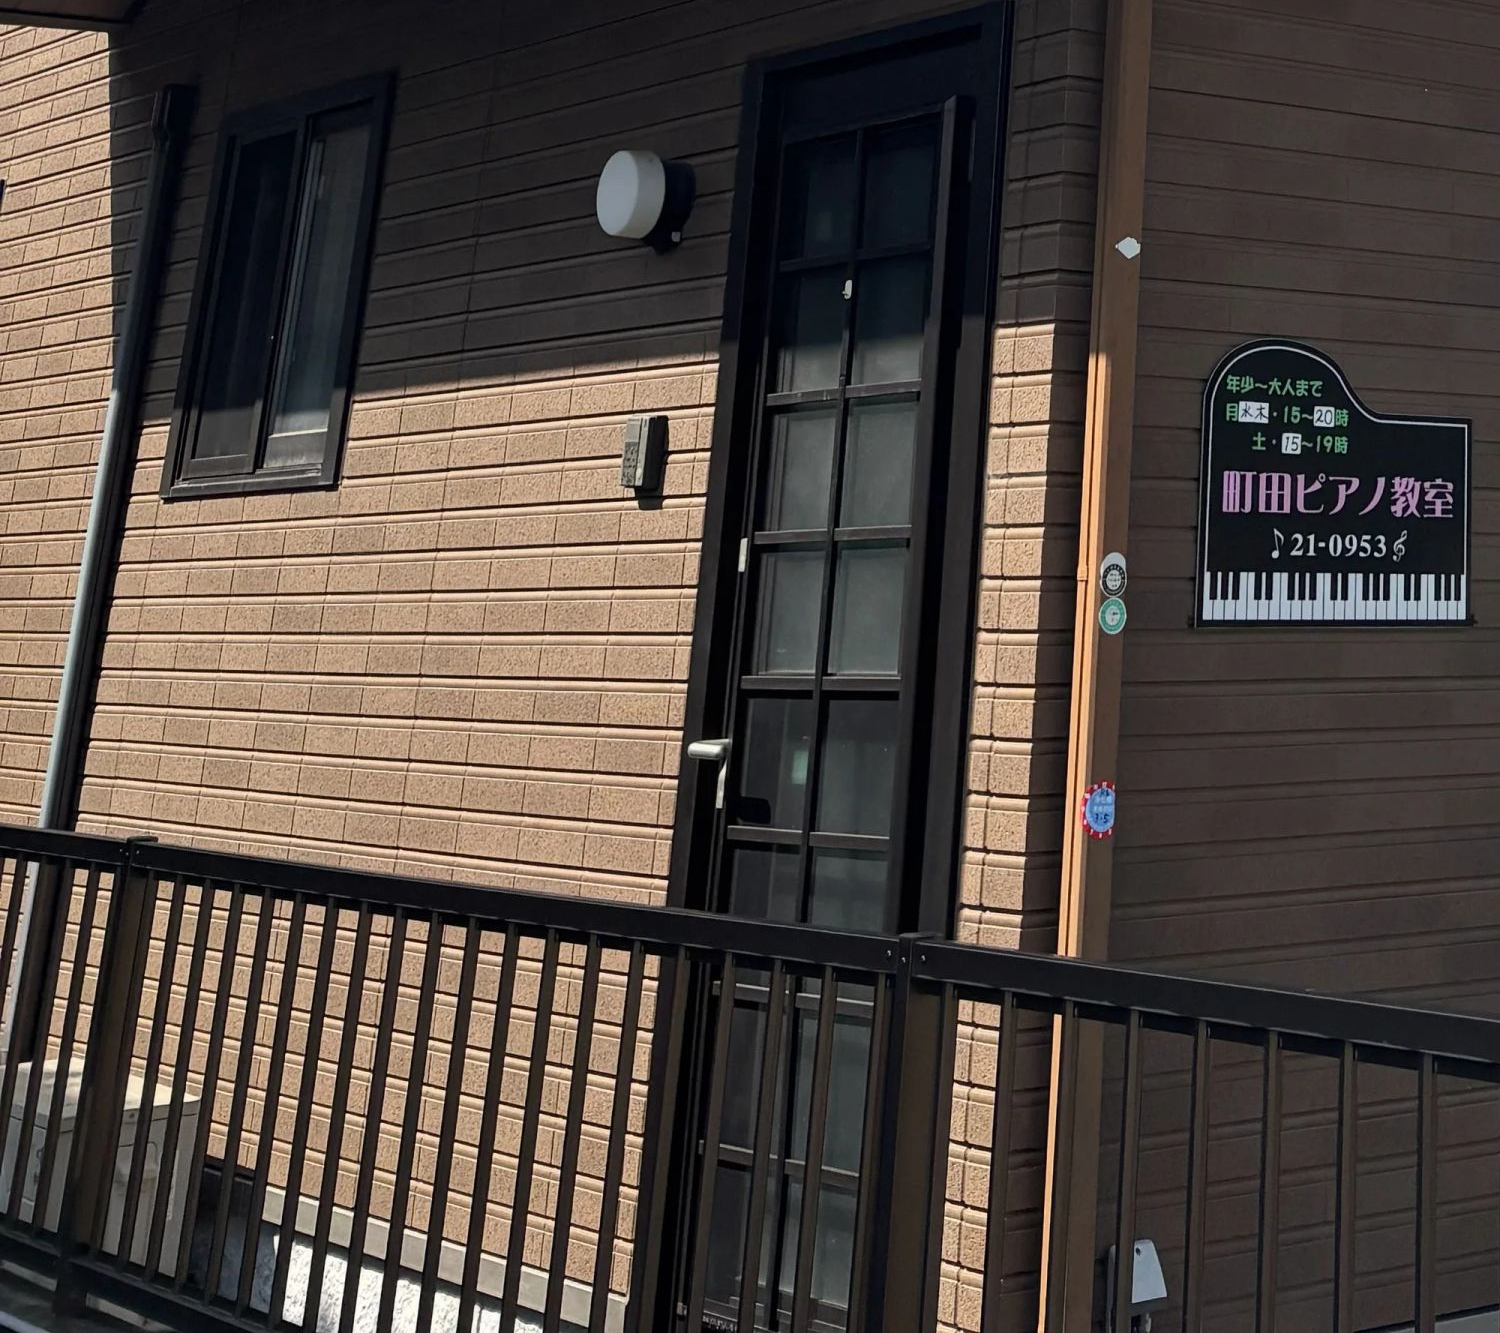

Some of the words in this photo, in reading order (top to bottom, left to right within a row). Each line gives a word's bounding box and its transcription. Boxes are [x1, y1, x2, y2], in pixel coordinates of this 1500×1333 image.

[1221, 470, 1454, 519] 町田ピアノ教室
[1289, 532, 1388, 558] 21-0953
